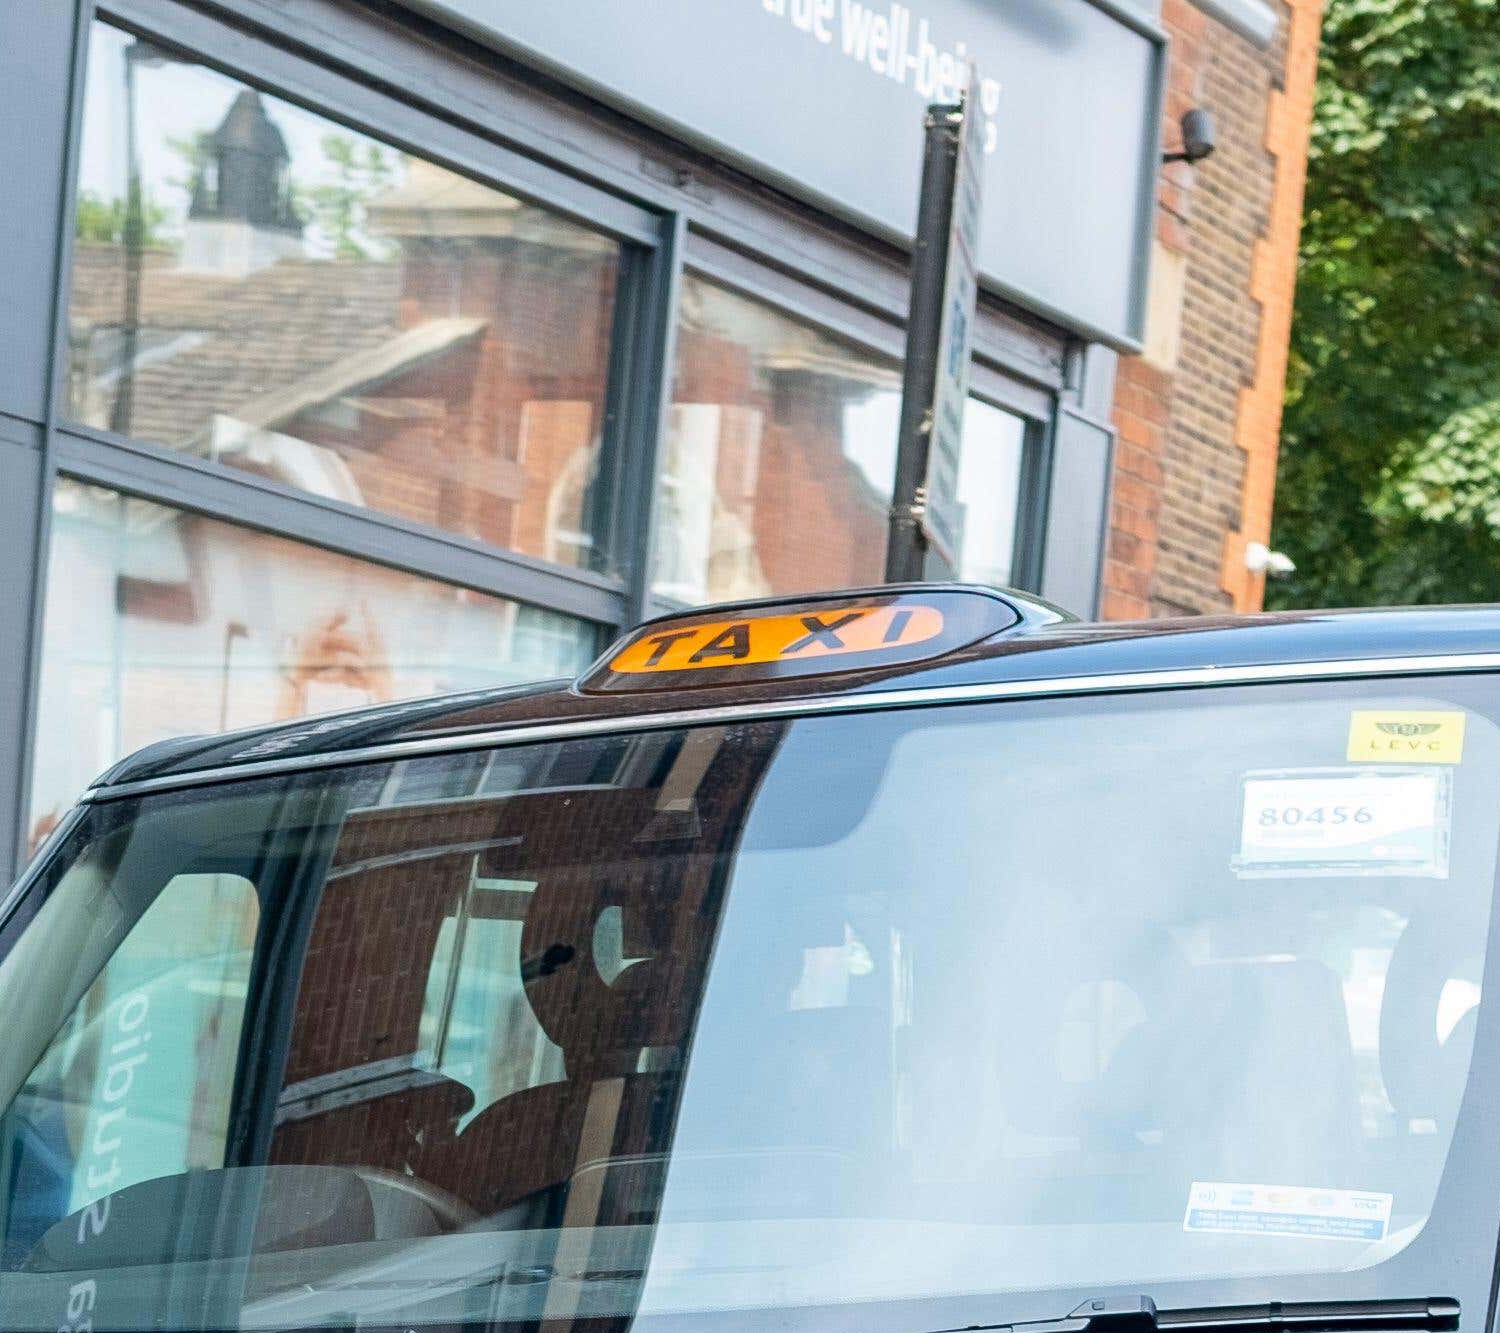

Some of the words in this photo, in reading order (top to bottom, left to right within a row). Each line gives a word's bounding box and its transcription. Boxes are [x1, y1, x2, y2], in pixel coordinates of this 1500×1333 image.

[841, 0, 1001, 154] well-beig
[644, 611, 914, 667] TAXI
[1369, 740, 1442, 753] LEVC
[1258, 806, 1374, 827] 80456
